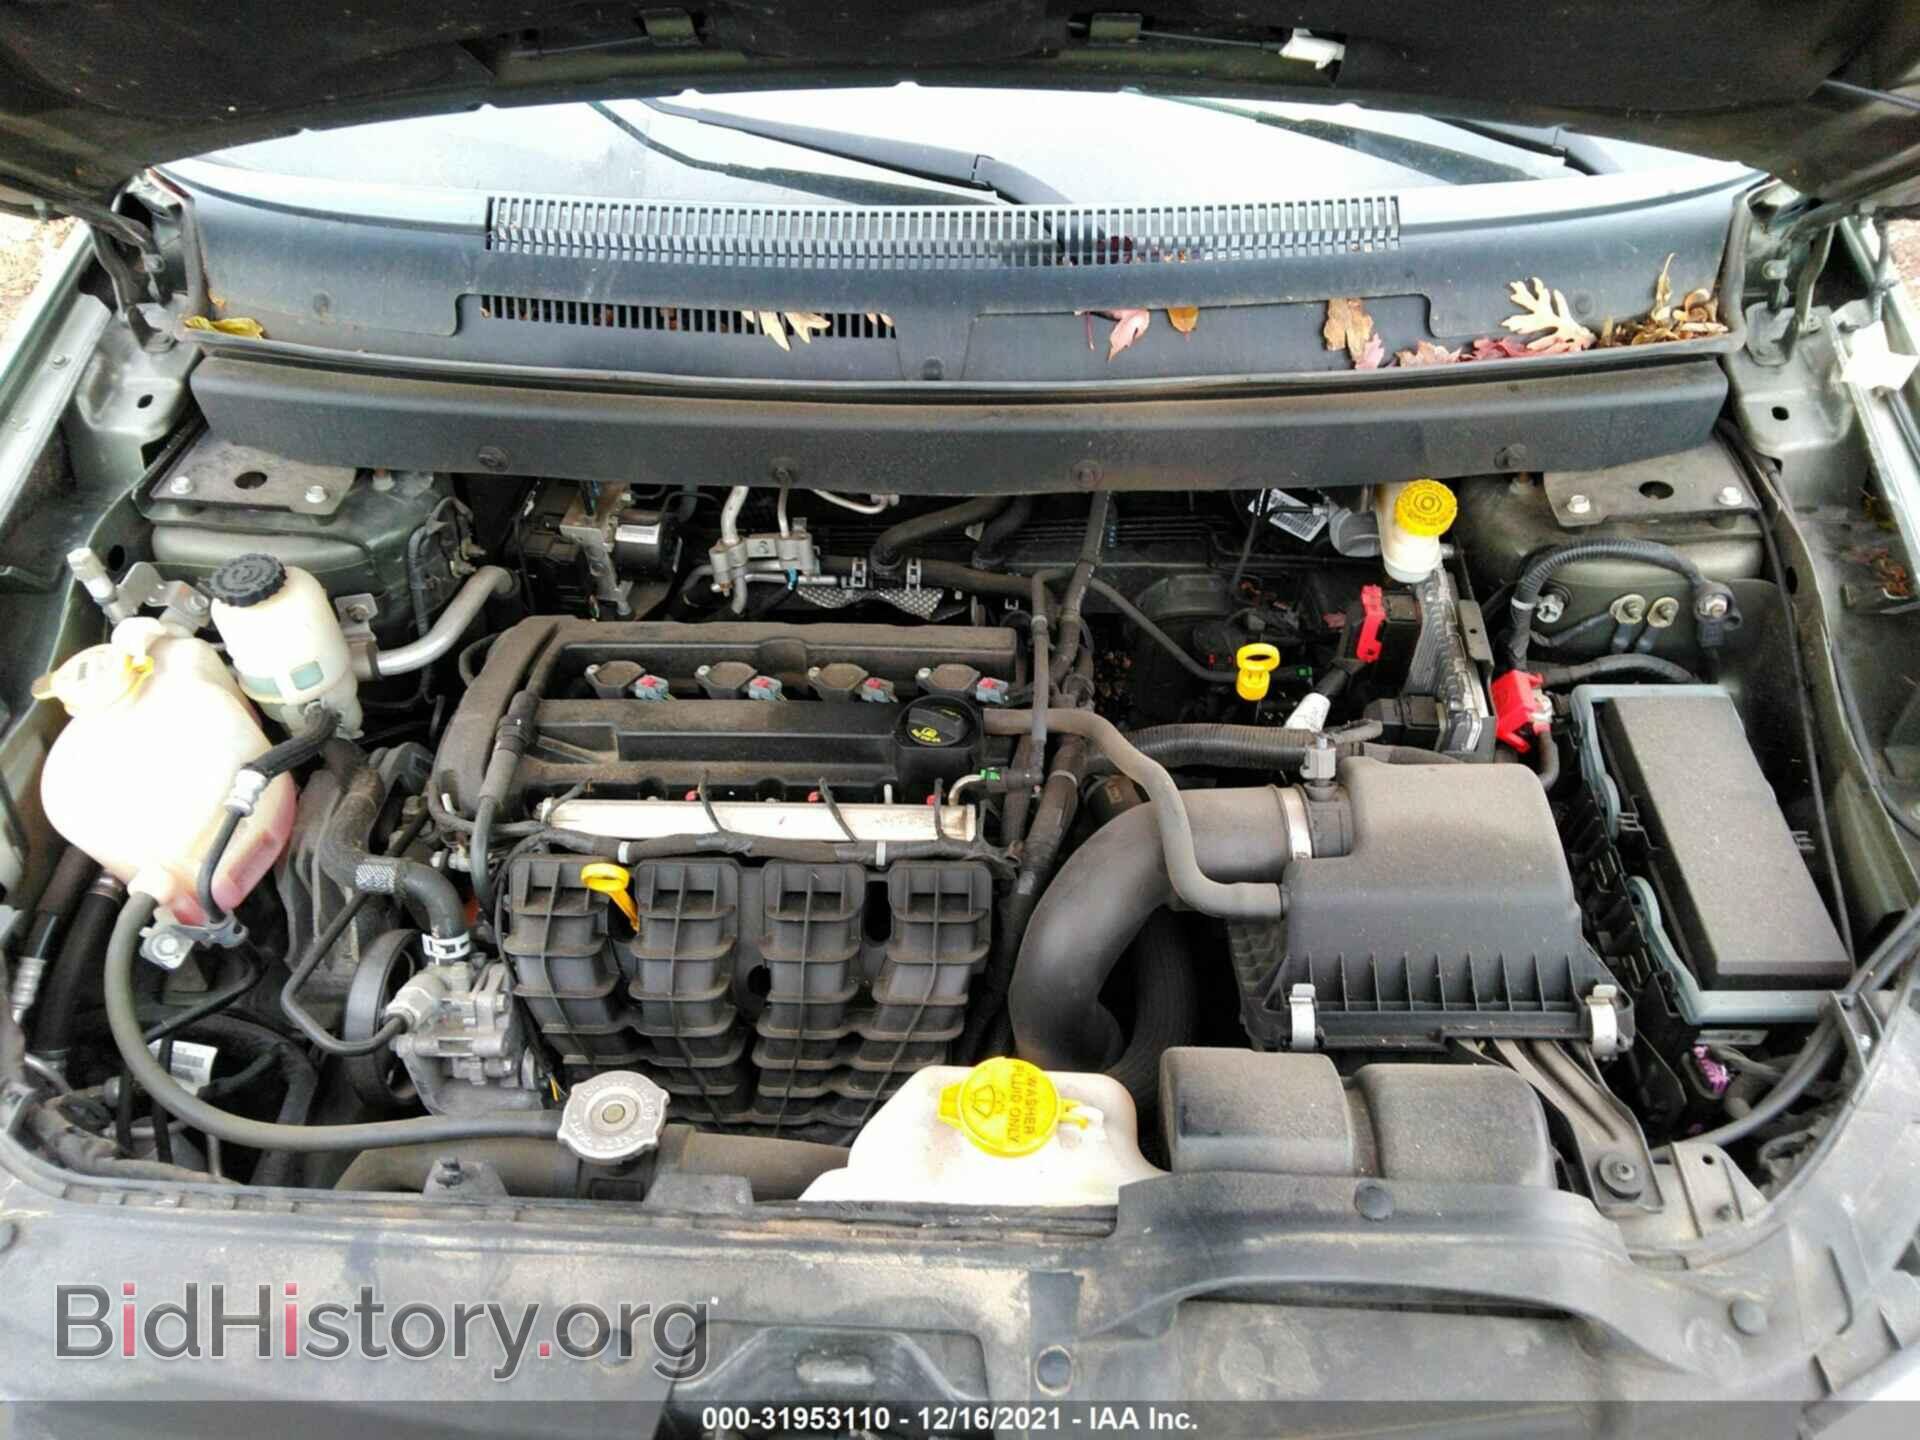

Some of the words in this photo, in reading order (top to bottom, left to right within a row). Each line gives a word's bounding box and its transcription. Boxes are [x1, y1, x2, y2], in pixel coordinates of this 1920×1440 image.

[1010, 1064, 1025, 1103] FLUID
[1007, 1107, 1022, 1143] ONLY
[1022, 1076, 1039, 1135] WASHER
